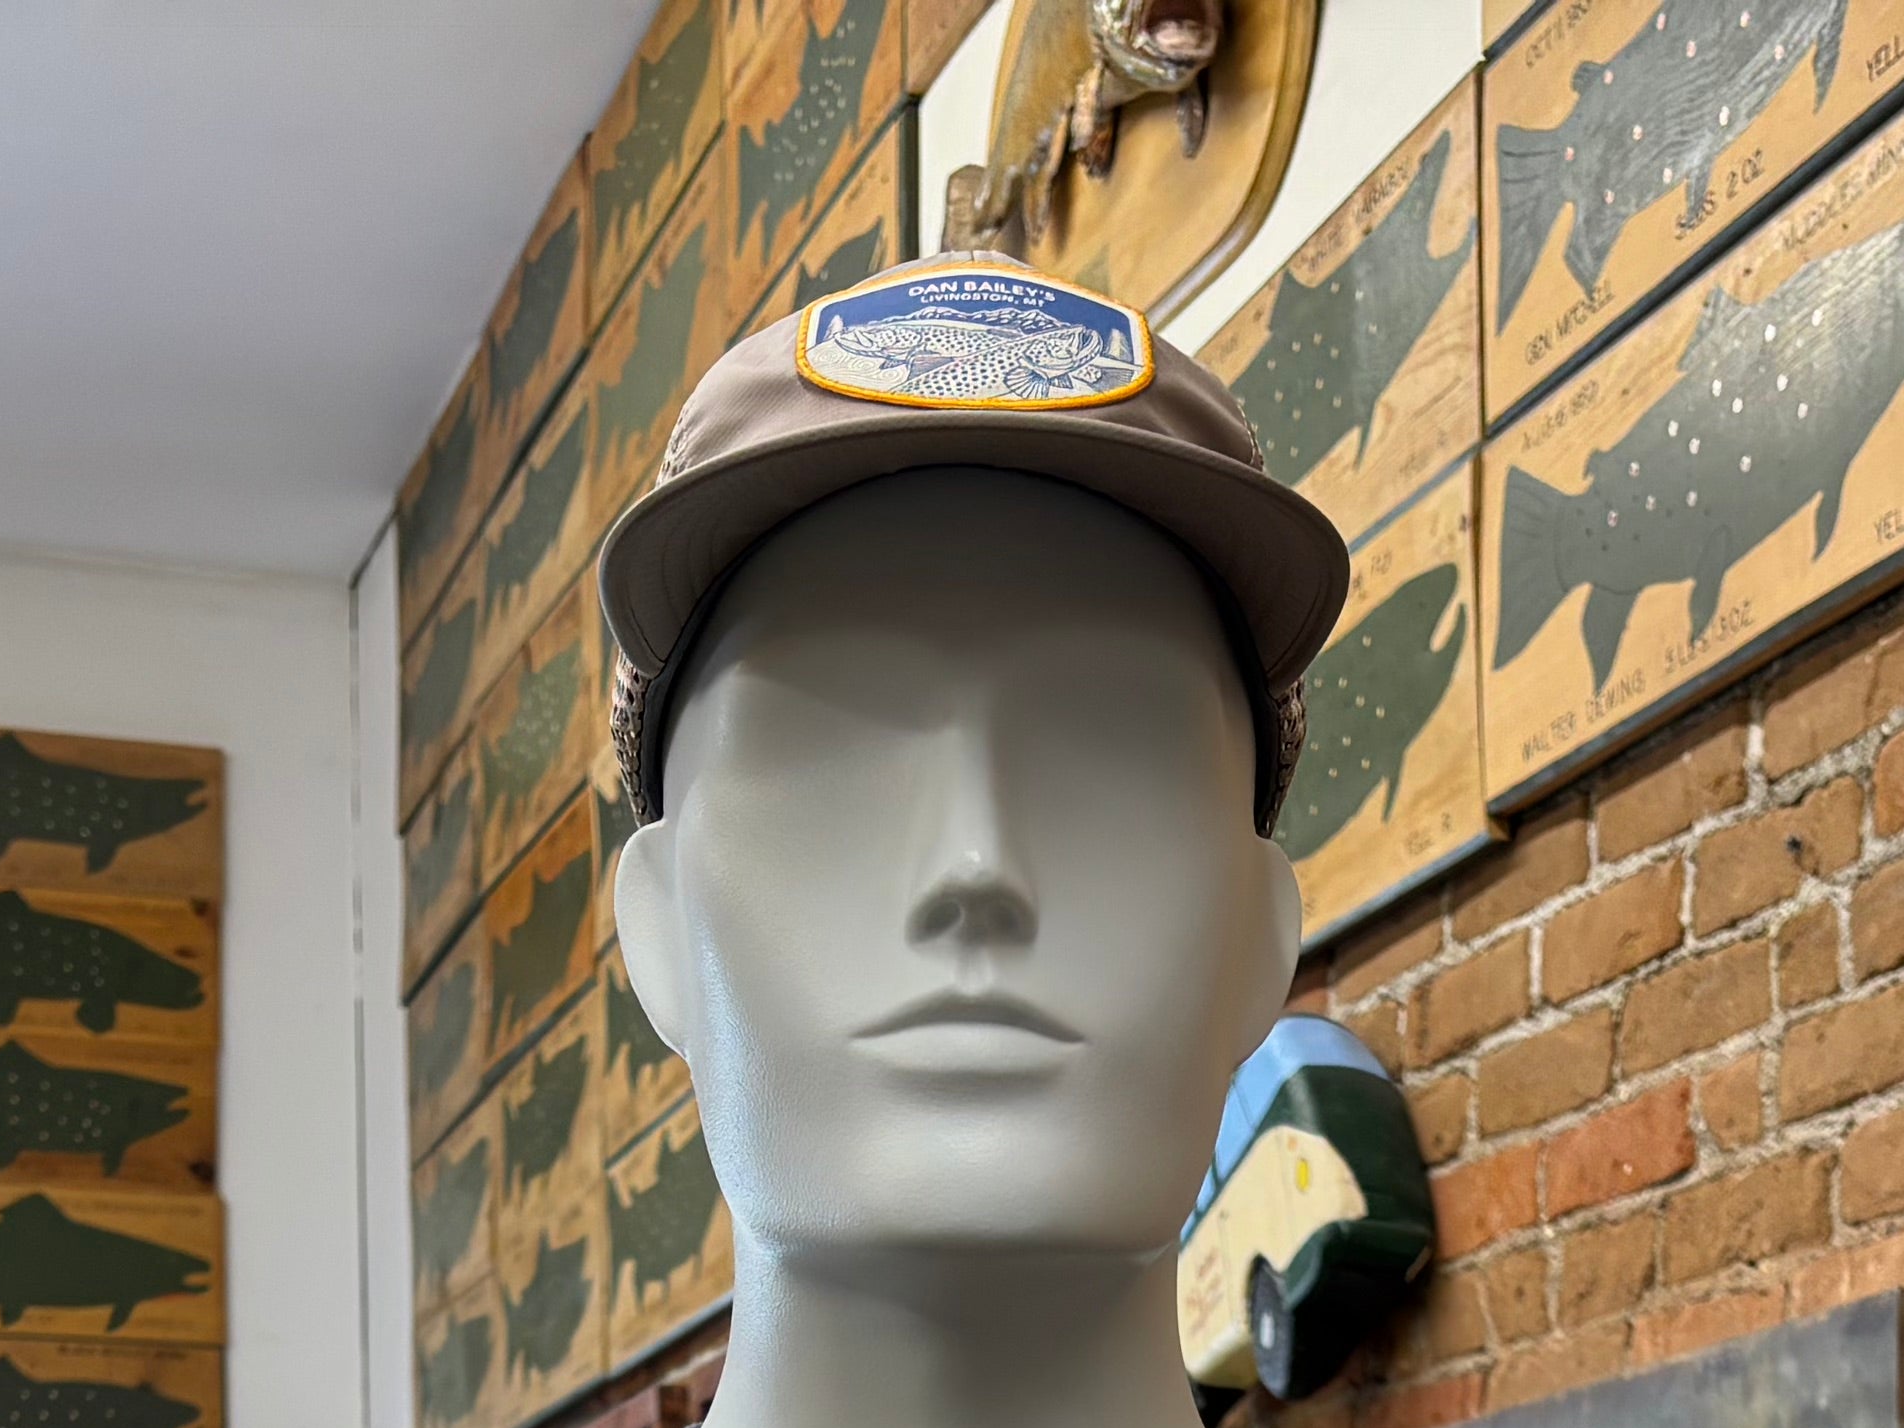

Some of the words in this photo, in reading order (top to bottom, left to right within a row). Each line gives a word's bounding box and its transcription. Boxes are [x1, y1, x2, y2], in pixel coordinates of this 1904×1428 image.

[908, 281, 958, 297] DAN
[964, 281, 1056, 302] BAILEY'S
[920, 292, 1019, 304] LIVINGSTON,
[1022, 297, 1045, 307] MT
